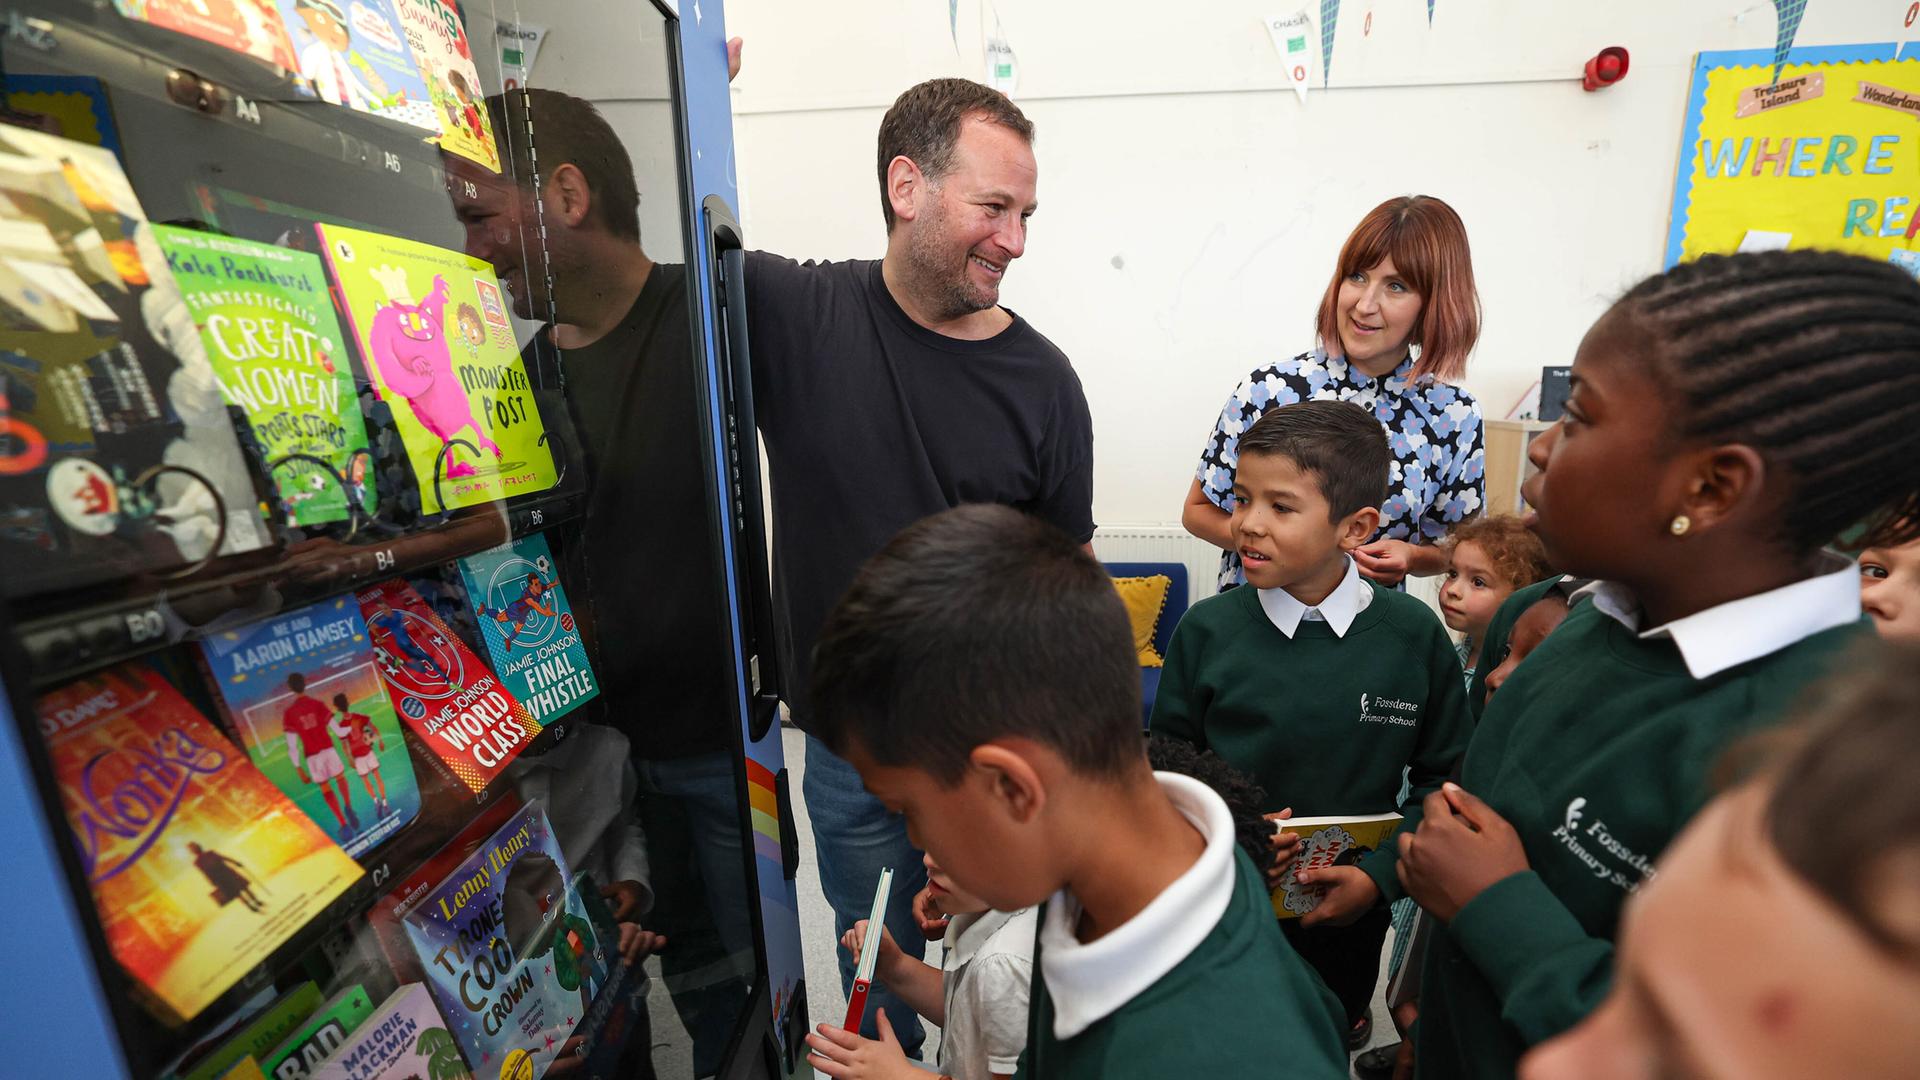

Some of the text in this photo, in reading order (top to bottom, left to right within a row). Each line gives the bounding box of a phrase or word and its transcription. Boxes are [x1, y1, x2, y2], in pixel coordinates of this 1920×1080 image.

[1753, 77, 1807, 98] Treasure
[1760, 89, 1800, 109] Island
[1862, 86, 1920, 112] Wonderlan
[236, 95, 261, 125] A4
[384, 151, 401, 173] A6
[1702, 135, 1900, 179] WHERE
[464, 181, 477, 199] A8
[186, 291, 318, 326] FANTASTICALLY
[207, 314, 319, 367] GREAT
[215, 366, 339, 416] WOMEN
[459, 364, 529, 394] MONSTER
[302, 413, 346, 448] STARS
[482, 396, 527, 430] POST
[531, 509, 543, 525] B6
[375, 549, 395, 571] B4
[231, 637, 295, 674] AARON
[295, 616, 355, 652] RAMSEY
[273, 616, 312, 637] ME AND
[504, 634, 578, 677] JAMIE JOHNSON
[524, 652, 576, 694] FINAL
[423, 704, 458, 736] JAMIE
[453, 674, 496, 713] JOHNSON
[520, 669, 593, 721] WHISTLE
[1374, 696, 1418, 711] Fossdene
[438, 690, 509, 752] WORLD
[472, 714, 527, 768] CLASS
[1359, 713, 1417, 727] Primary School
[1552, 825, 1612, 878] Primary
[1586, 819, 1657, 882] Fossde
[373, 863, 390, 887] C4
[438, 823, 531, 921] Lenny Henry
[433, 892, 504, 976] TYRONE'
[459, 937, 513, 1012] COO
[483, 966, 535, 1037] CROWN
[341, 1011, 404, 1073] MALORIE
[345, 1018, 418, 1080] LACKMAN
